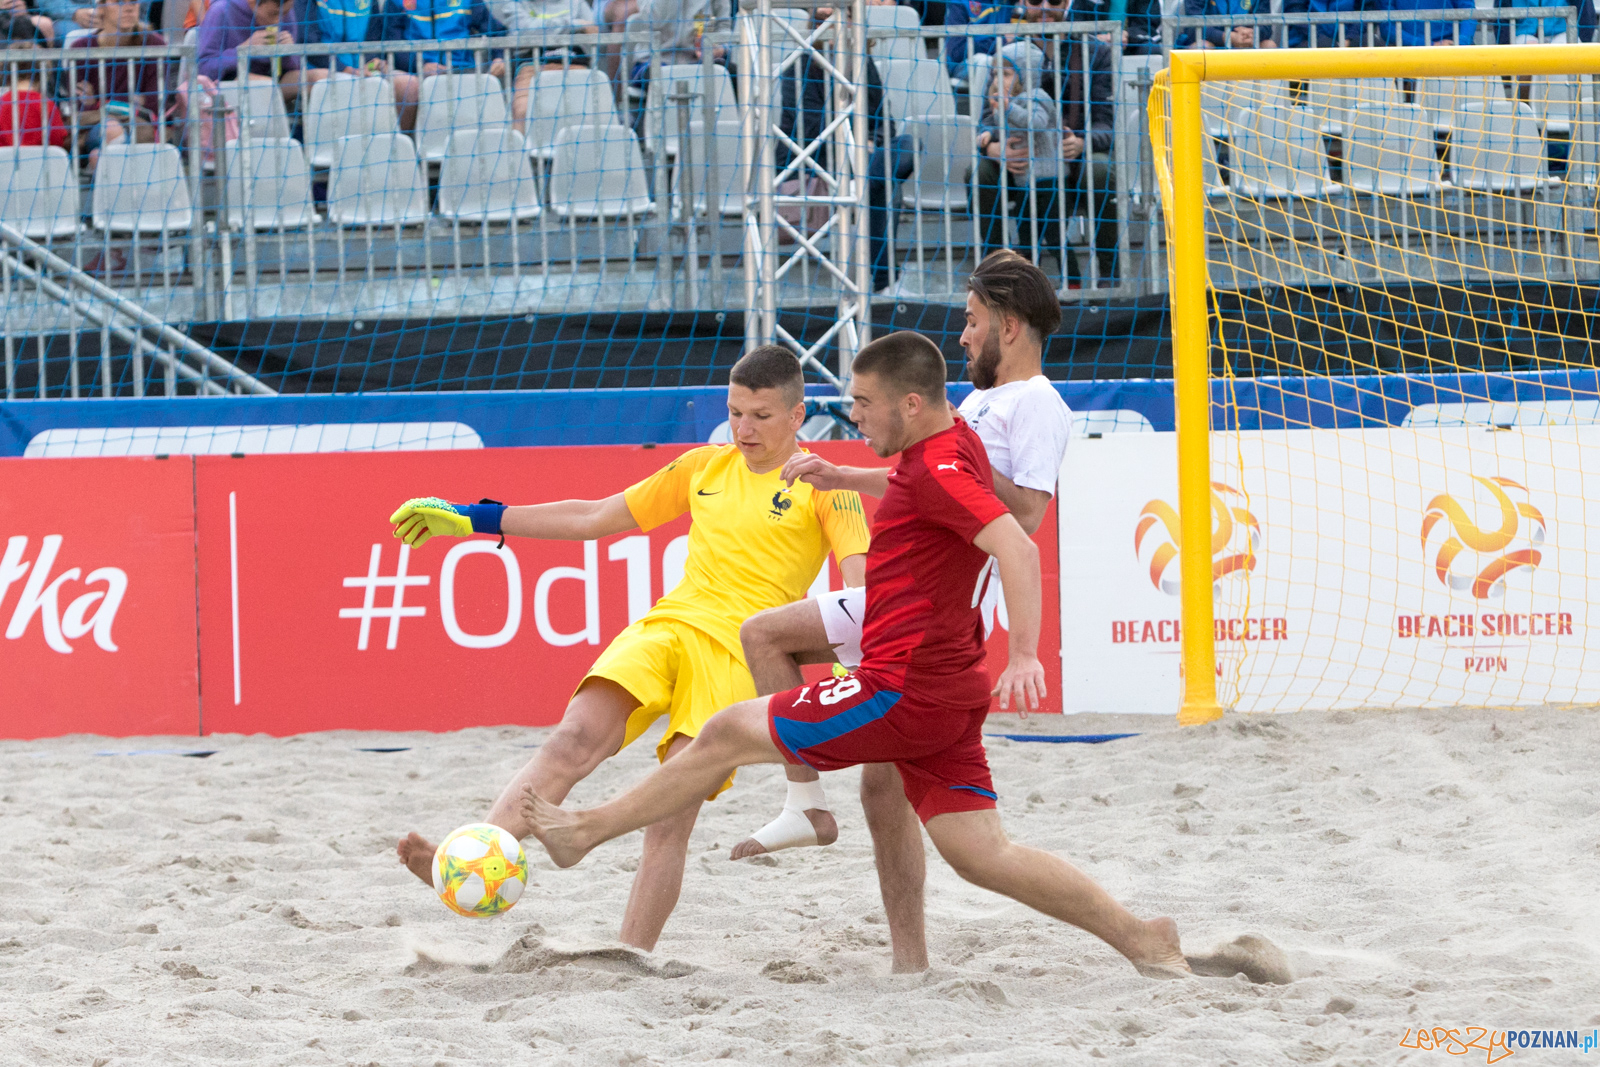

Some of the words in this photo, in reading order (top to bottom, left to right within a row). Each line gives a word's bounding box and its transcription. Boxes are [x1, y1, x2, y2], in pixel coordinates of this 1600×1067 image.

[1214, 618, 1288, 641] OCCER
[1398, 614, 1474, 638] BEACH
[1481, 612, 1573, 637] SOCCER
[1464, 656, 1508, 673] PZPN
